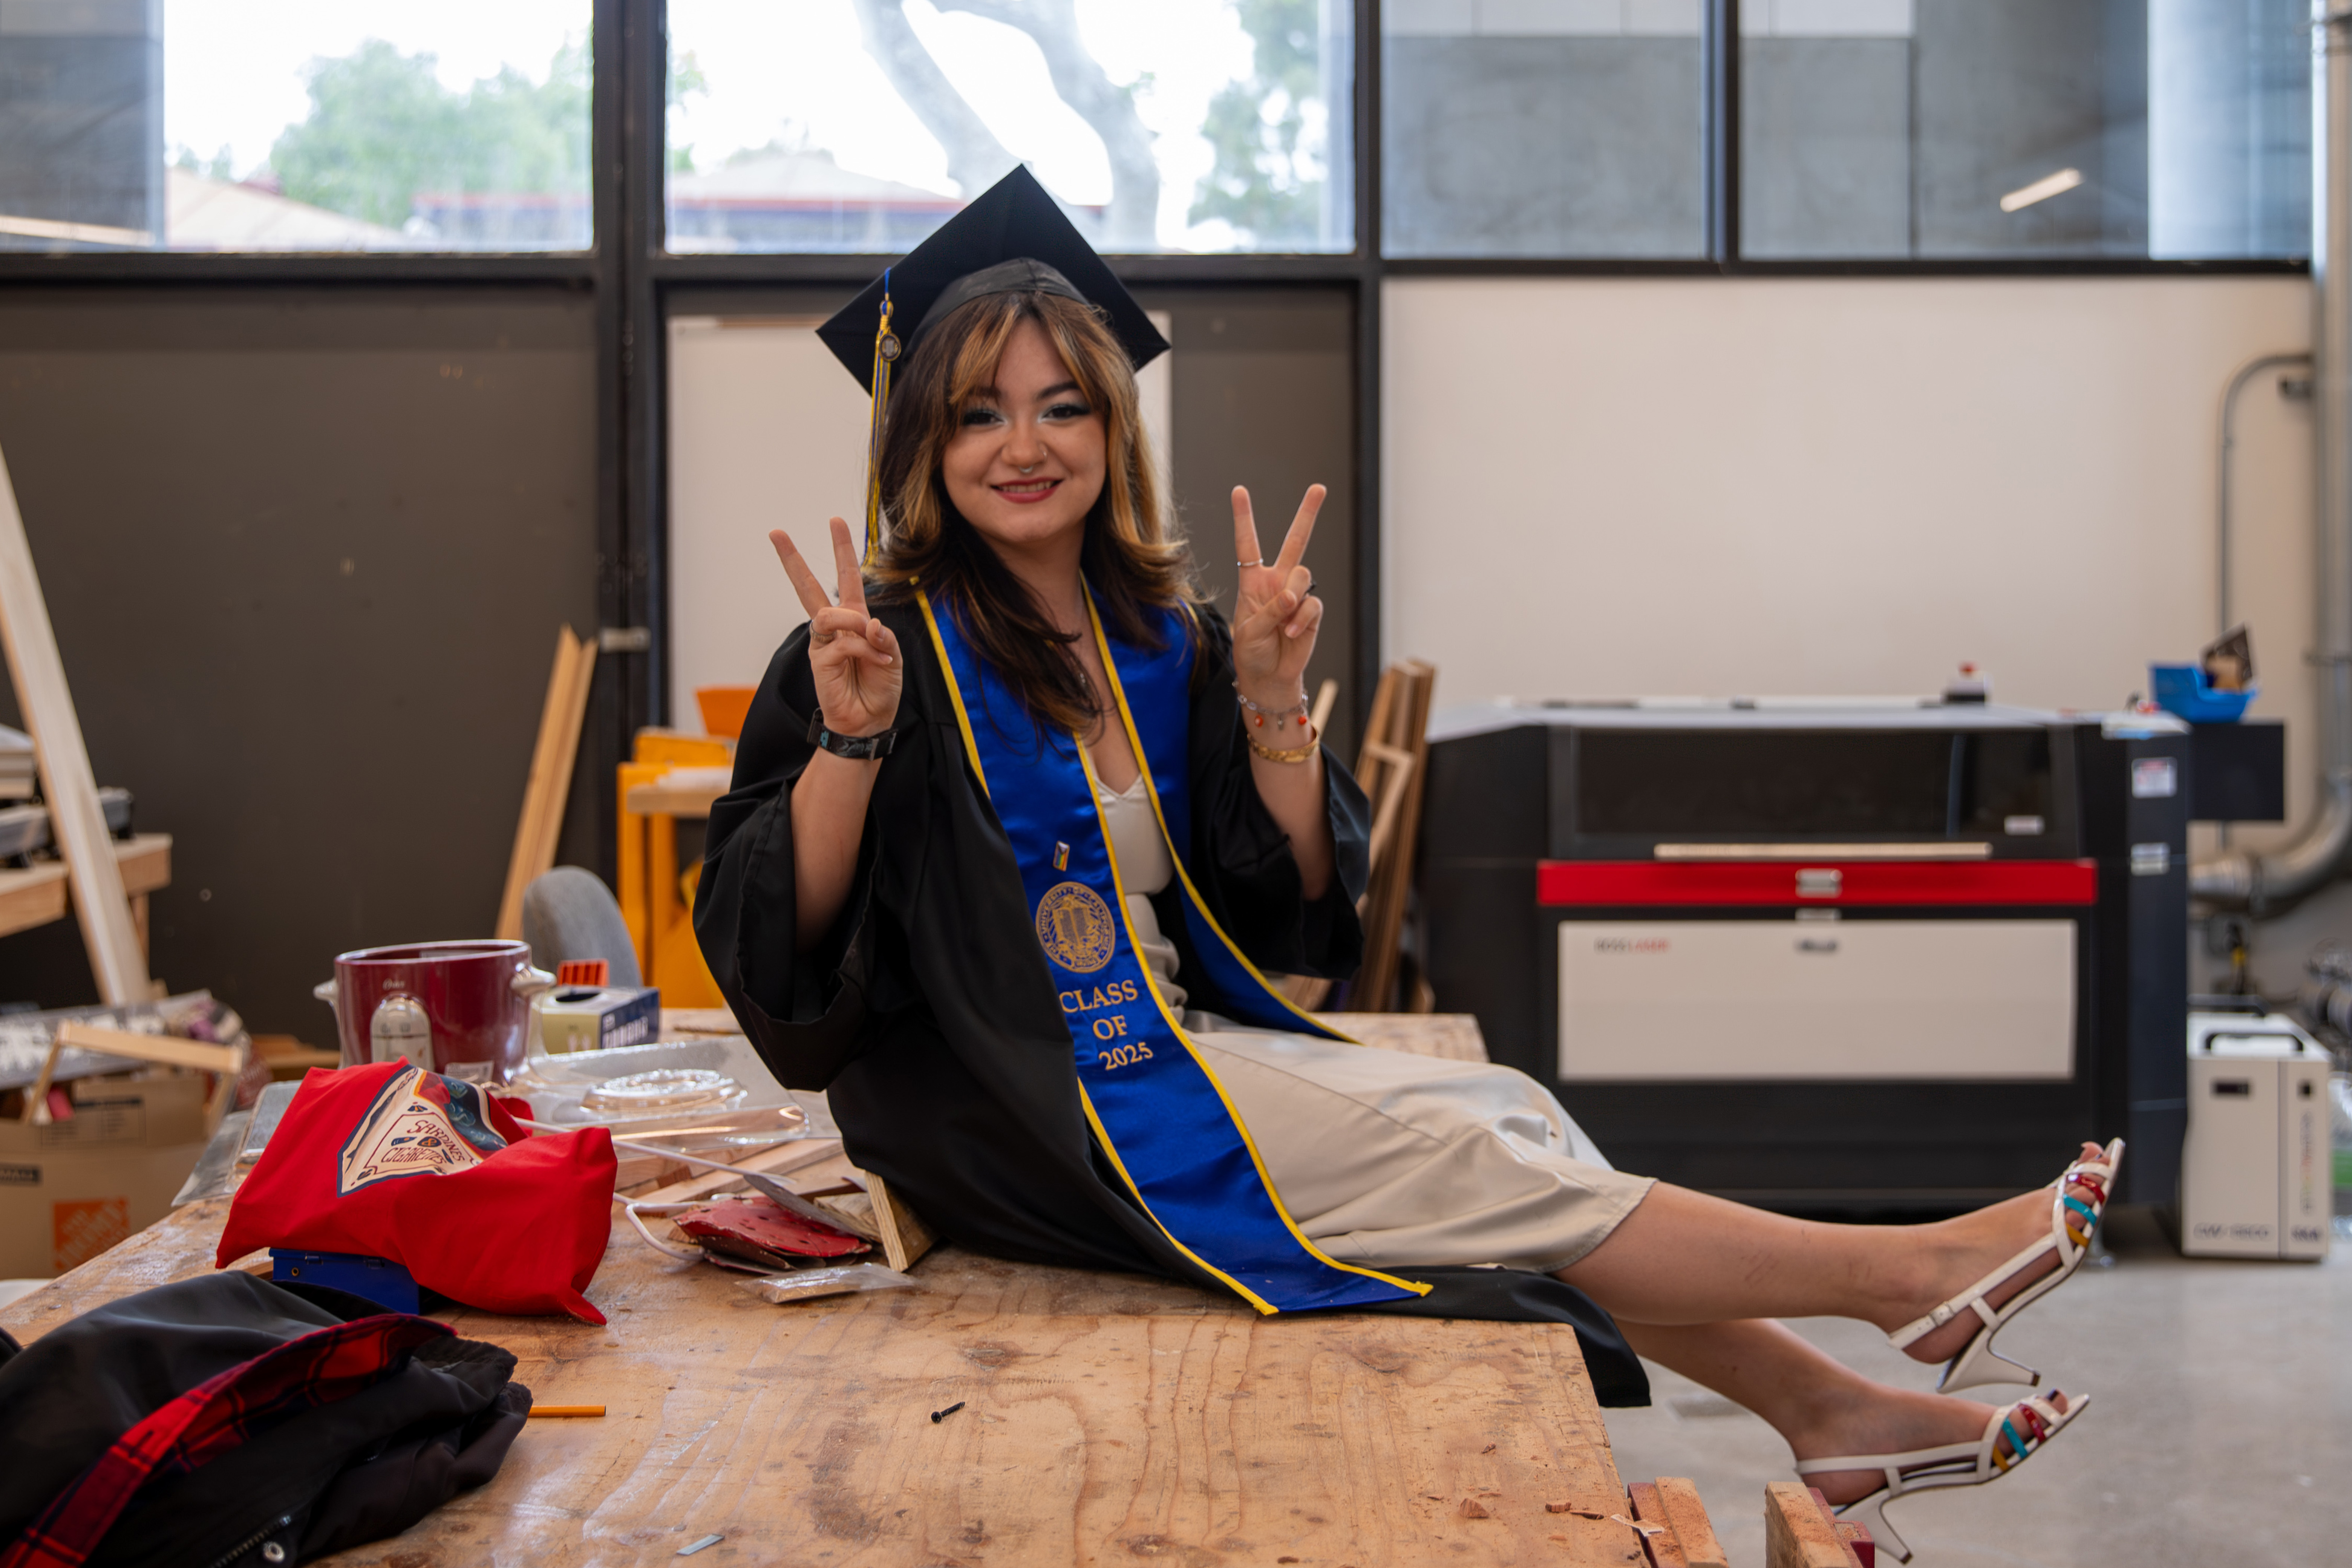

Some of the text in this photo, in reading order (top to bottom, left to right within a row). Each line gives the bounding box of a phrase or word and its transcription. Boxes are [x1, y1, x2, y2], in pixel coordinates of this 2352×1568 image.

[1059, 980, 1138, 1013] CLASS
[1093, 1015, 1127, 1040] OF
[1099, 1042, 1153, 1070] 2025
[407, 1120, 465, 1161] SARDINES
[381, 1147, 447, 1164] CIGARETTES
